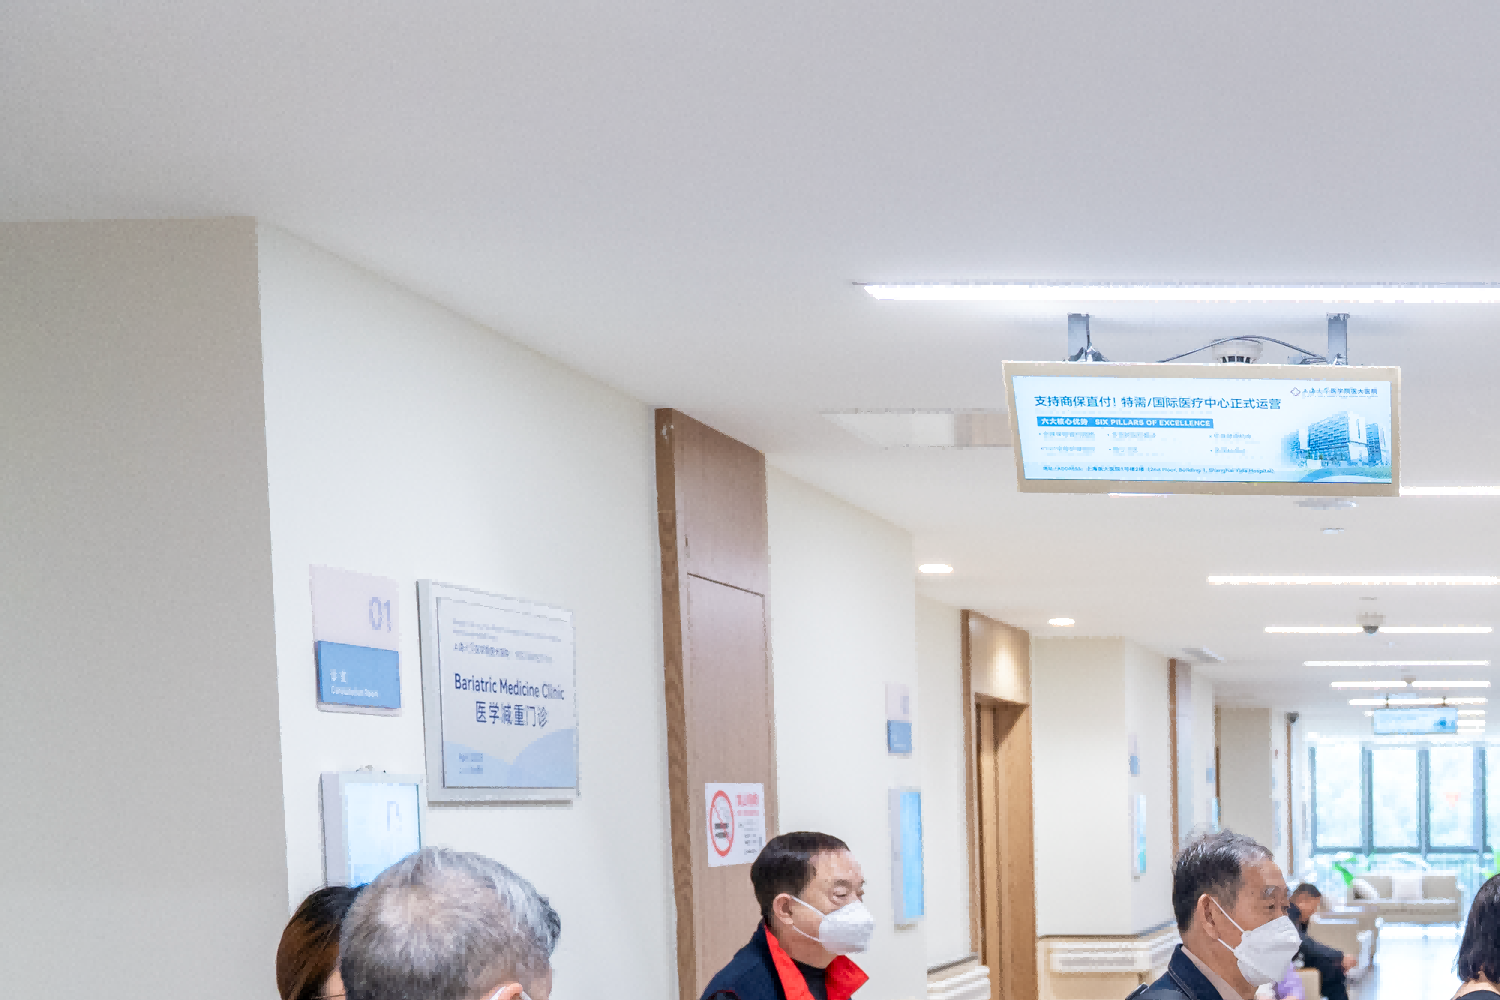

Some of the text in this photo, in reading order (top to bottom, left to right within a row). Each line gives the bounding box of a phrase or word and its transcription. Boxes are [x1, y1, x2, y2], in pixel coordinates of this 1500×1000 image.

[1121, 396, 1281, 410] 特需/国际医疗中心正式运营
[1041, 417, 1089, 426] 六大核心优势
[1095, 418, 1109, 426] SIX
[1159, 419, 1211, 427] EXCELLENCE
[368, 596, 392, 633] 01
[454, 672, 565, 700] Bariatric Medicine Clinic
[475, 700, 549, 728] 医学减重门诊
